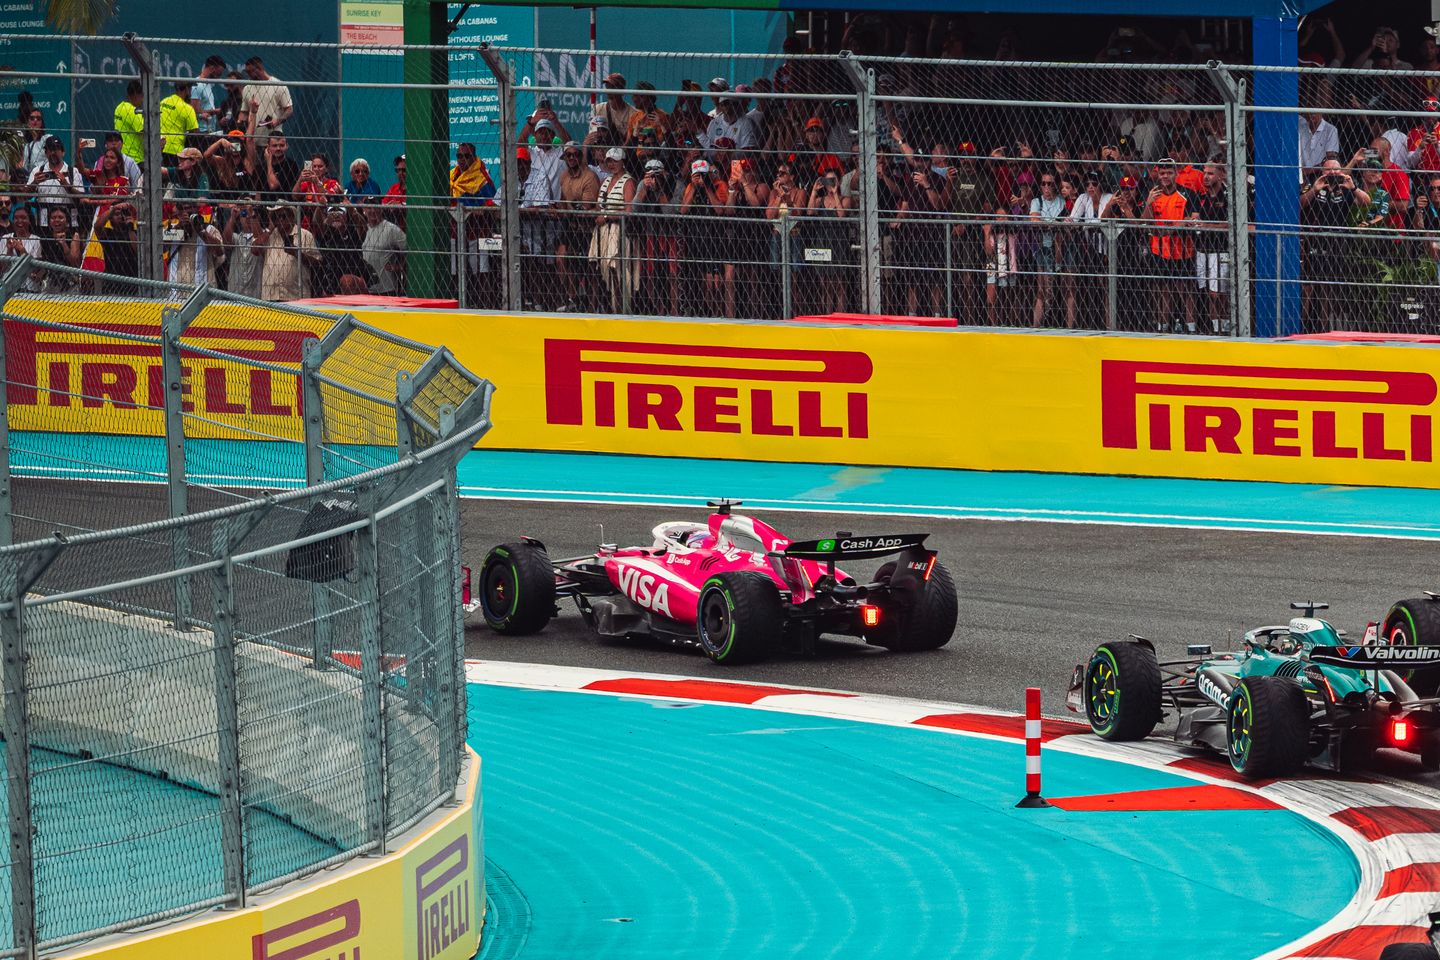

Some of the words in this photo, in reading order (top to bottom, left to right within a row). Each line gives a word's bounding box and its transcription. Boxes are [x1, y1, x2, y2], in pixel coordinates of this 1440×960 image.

[19, 20, 44, 28] LOUNGE
[467, 17, 497, 26] CABANAS
[482, 34, 508, 42] LOUNGE
[455, 53, 475, 61] LOFTS
[460, 116, 473, 124] AND
[544, 338, 873, 439] PIRELLI
[1101, 360, 1438, 462] PIRELLI
[841, 539, 873, 549] Cash
[874, 538, 902, 547] App
[618, 564, 673, 619] VISA
